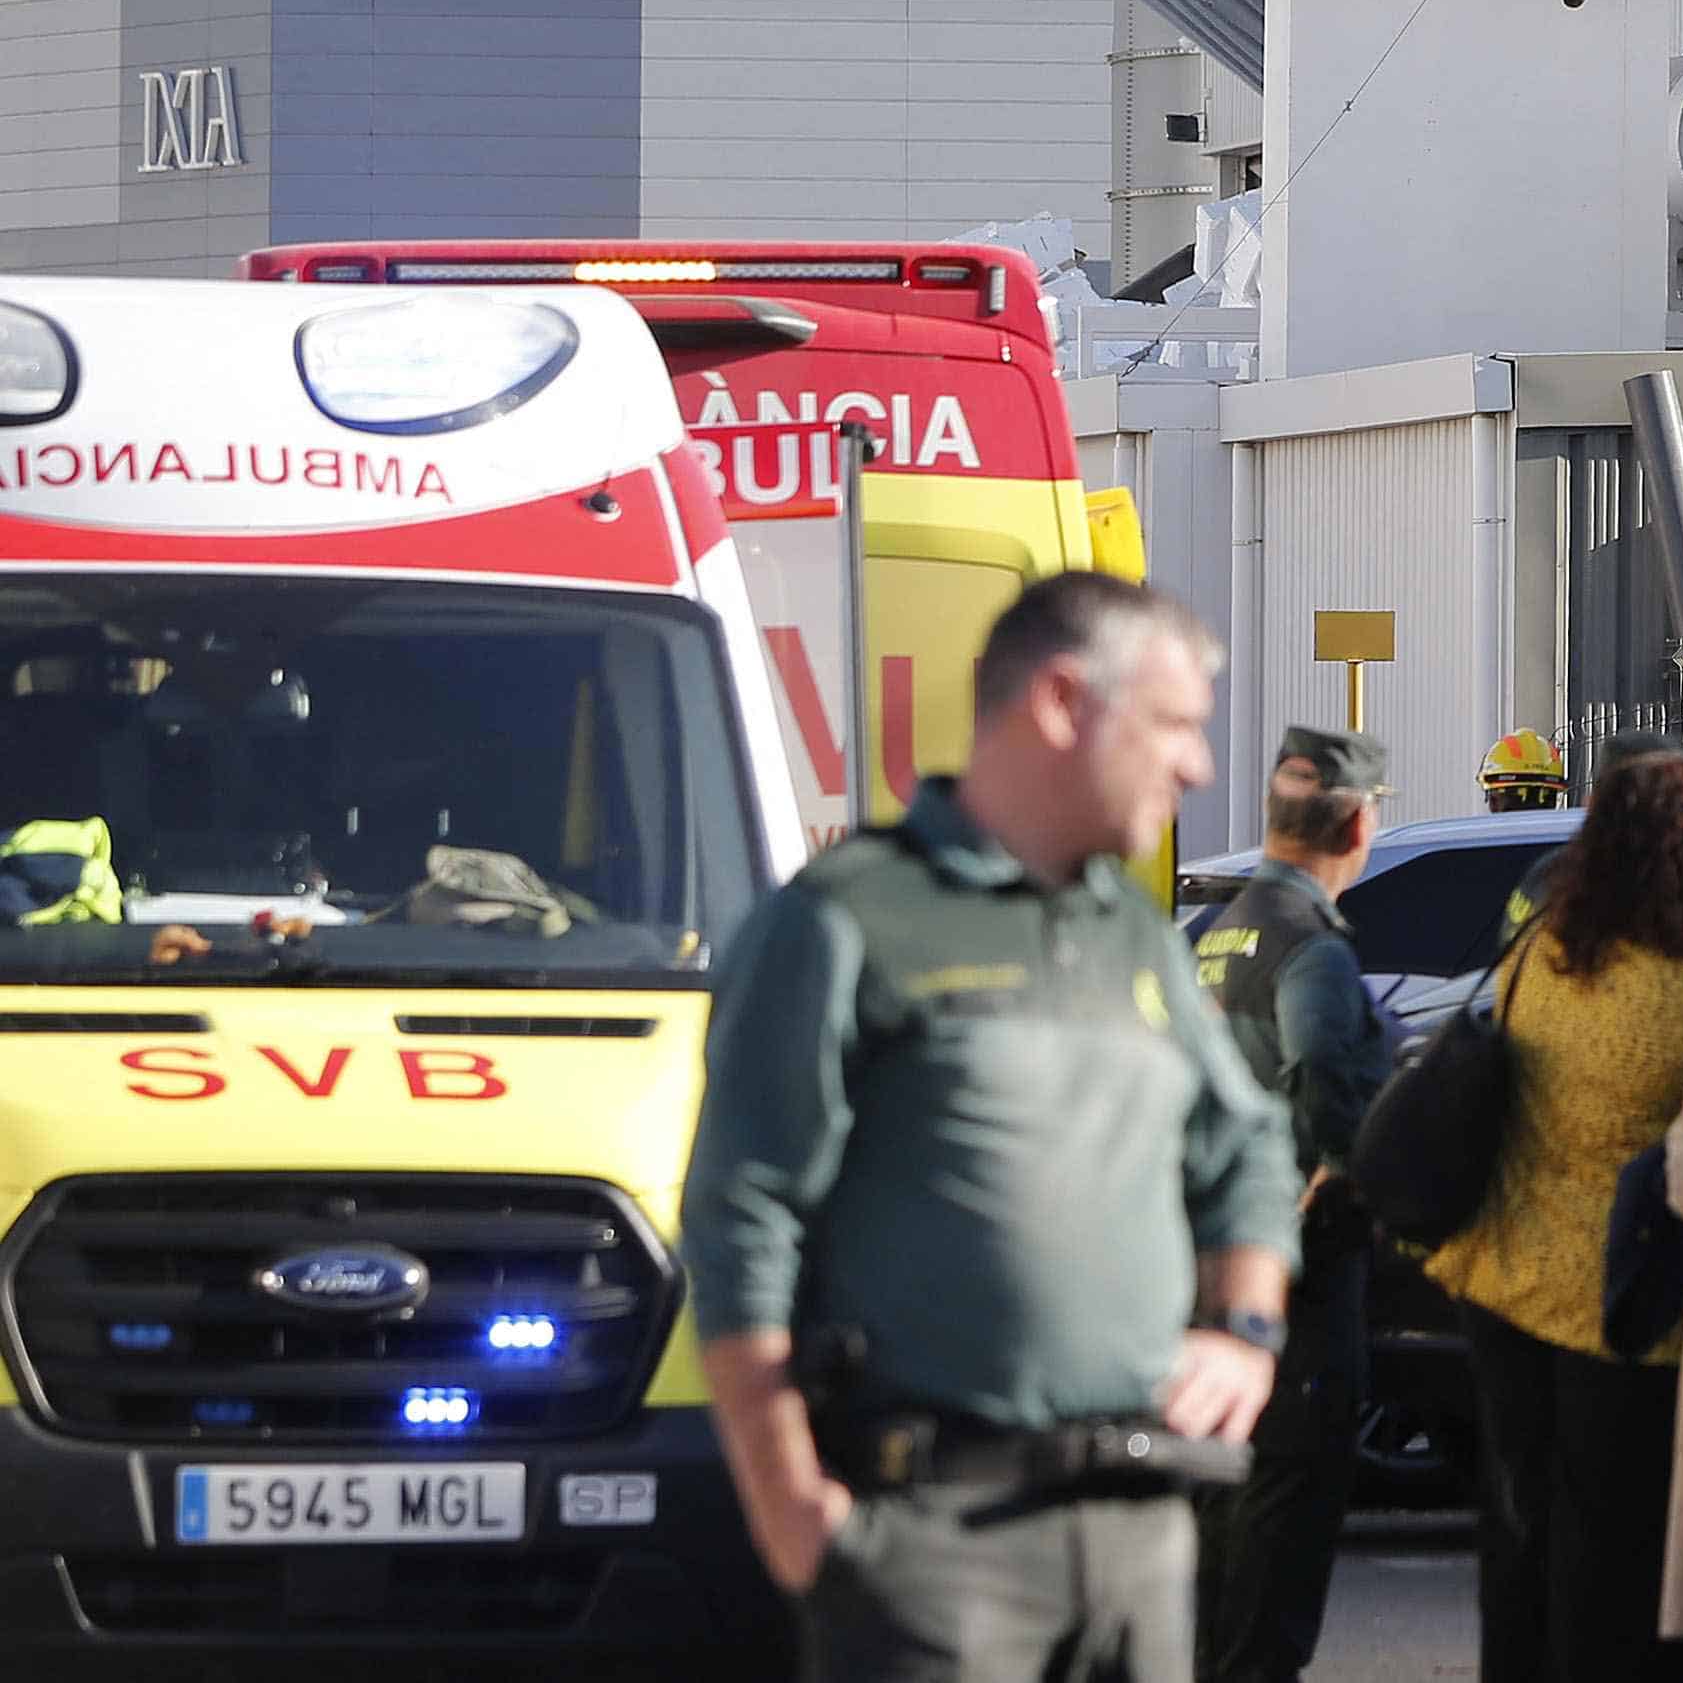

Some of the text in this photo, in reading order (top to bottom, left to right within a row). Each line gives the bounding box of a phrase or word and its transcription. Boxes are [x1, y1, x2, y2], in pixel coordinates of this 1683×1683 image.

[120, 1047, 508, 1100] SVB
[225, 1475, 505, 1532] 5945 MGL
[573, 1481, 648, 1517] SP
